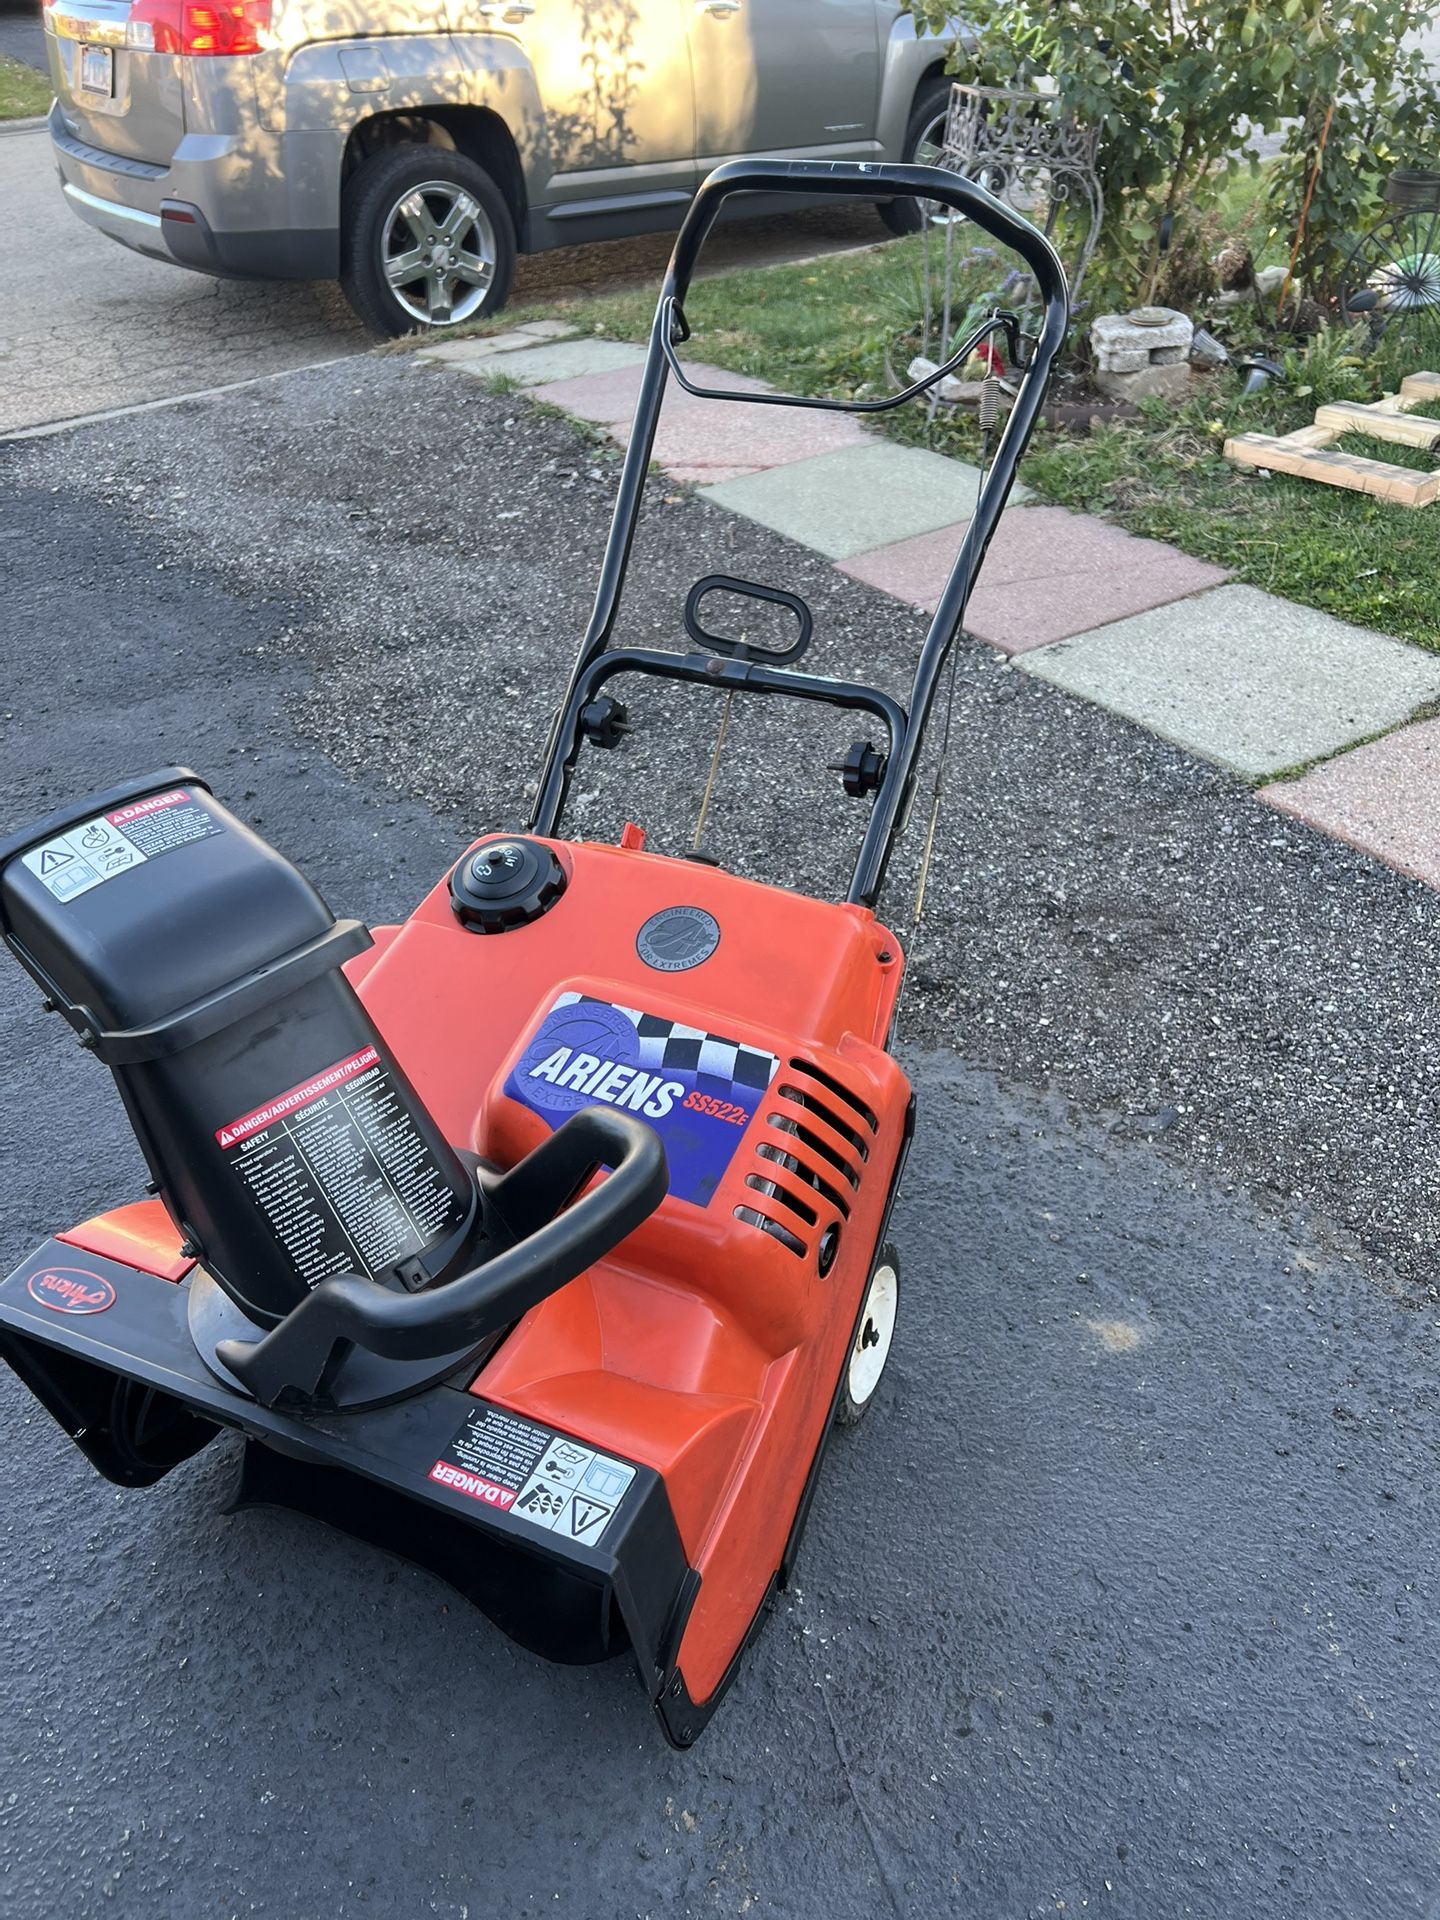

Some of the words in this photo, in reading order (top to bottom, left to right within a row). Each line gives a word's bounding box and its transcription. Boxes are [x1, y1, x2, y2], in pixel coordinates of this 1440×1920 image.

[122, 793, 184, 819] DANGER
[648, 907, 713, 927] ENGINEERED
[639, 943, 653, 960] FOR
[652, 949, 709, 969] EXTREMES
[344, 1067, 381, 1093] SEGURIDAD
[529, 1046, 686, 1119] ARIENS
[682, 1091, 750, 1127] SS522E
[231, 1050, 378, 1138] DANGER/ADVERTISSEMENT/PELIGRO
[294, 1096, 330, 1123] SÉCURITÉ
[239, 1130, 271, 1153] SAFETY
[456, 1450, 480, 1464] running.
[461, 1462, 480, 1473] auger
[485, 1463, 507, 1475] engine
[486, 1472, 503, 1482] clear
[506, 1471, 523, 1482] while
[432, 1464, 501, 1502] DANGER
[502, 1478, 520, 1490] Keep
